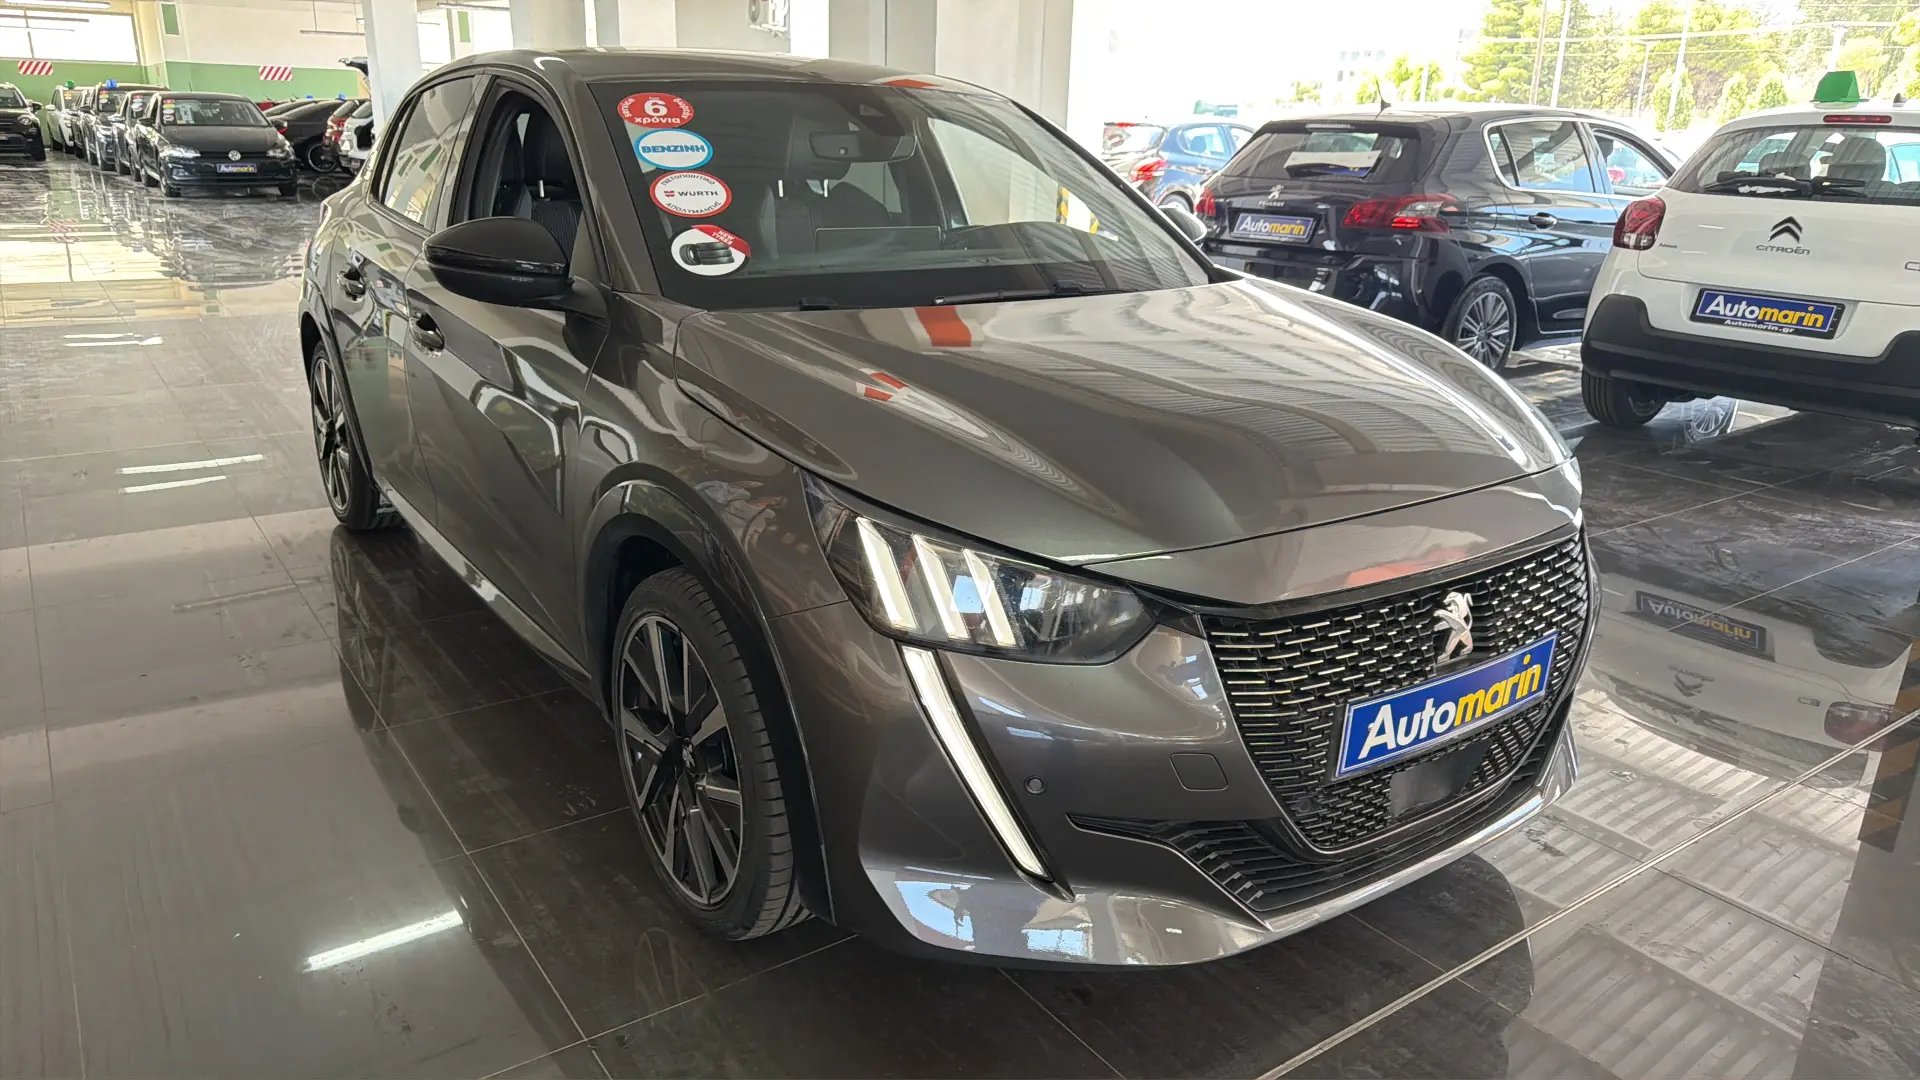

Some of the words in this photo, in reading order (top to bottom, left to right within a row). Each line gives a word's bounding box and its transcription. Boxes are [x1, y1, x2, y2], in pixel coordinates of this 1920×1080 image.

[644, 99, 668, 117] 6
[634, 116, 680, 125] χρόνια
[641, 145, 706, 153] ΒΕΝΖΙΝΗ
[1239, 215, 1305, 235] Automarin
[1704, 294, 1825, 328] Automarin
[1723, 319, 1796, 334] Automarin.gr
[1357, 653, 1542, 760] Automarin
